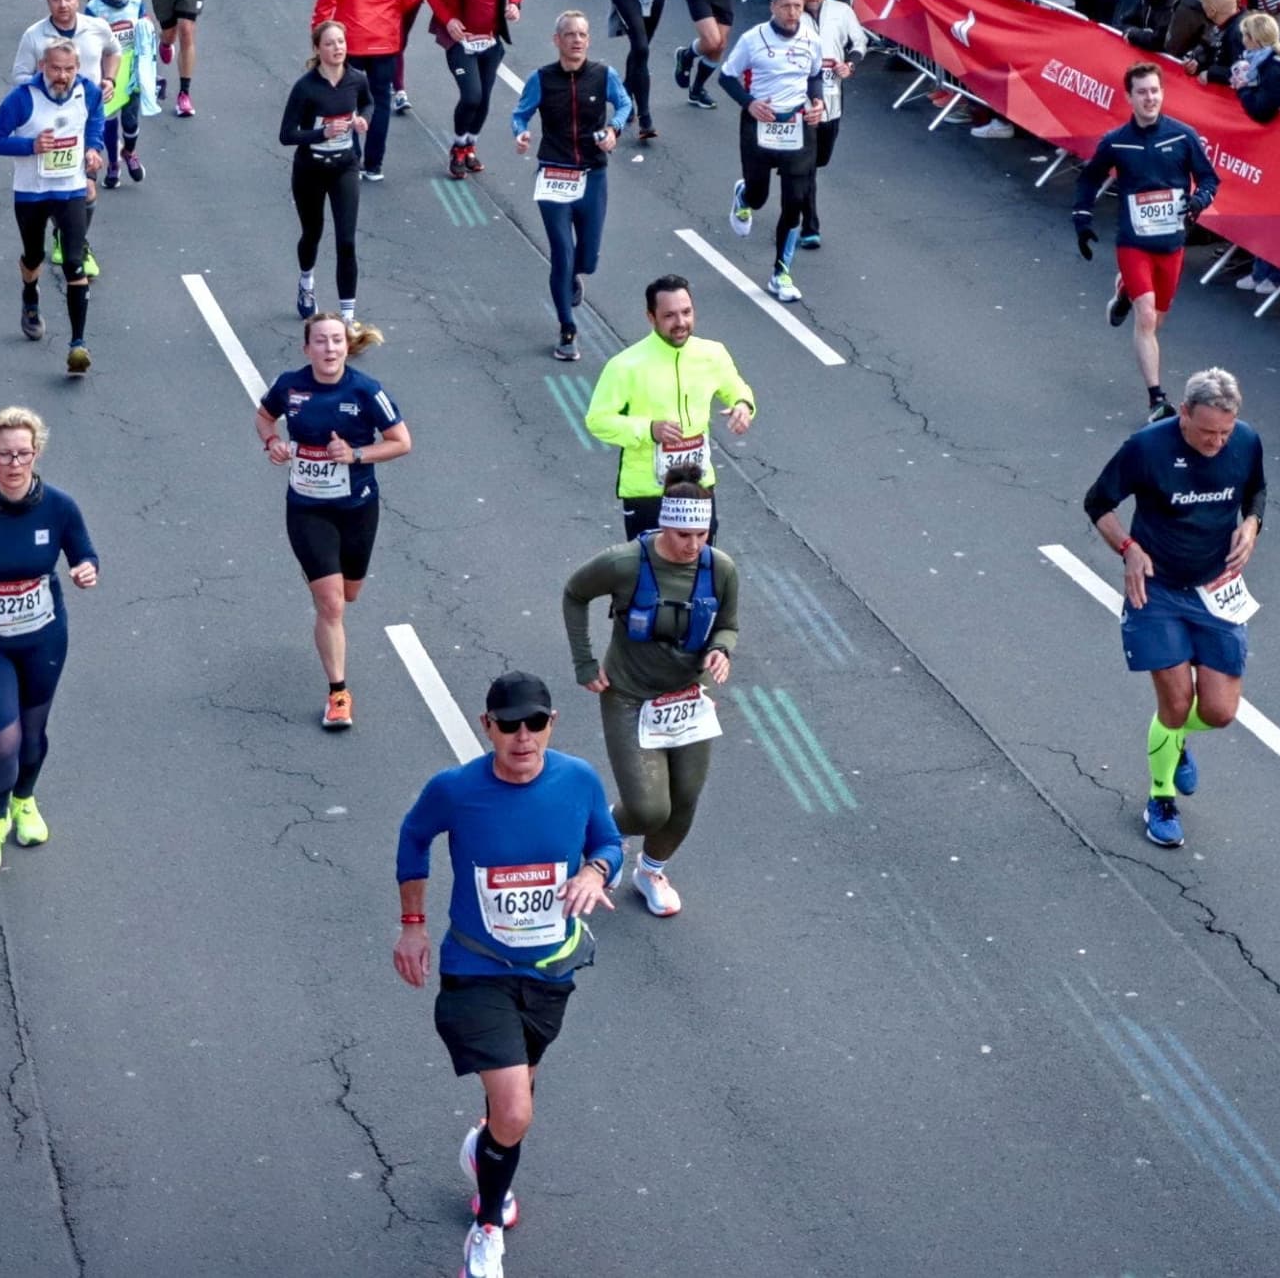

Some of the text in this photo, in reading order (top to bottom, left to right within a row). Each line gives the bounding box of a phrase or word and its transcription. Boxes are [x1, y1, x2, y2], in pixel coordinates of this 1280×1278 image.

[1056, 65, 1115, 111] GENERALI
[765, 123, 797, 135] 28247
[52, 149, 73, 164] 776
[1219, 151, 1264, 185] EVENTS
[545, 181, 578, 192] 18678
[1139, 203, 1175, 220] 50913
[297, 460, 338, 478] 54947
[1170, 487, 1236, 505] Fabasoft
[652, 701, 697, 725] 37281
[506, 871, 551, 885] GENERALI
[493, 889, 554, 915] 16380
[513, 917, 535, 926] John
